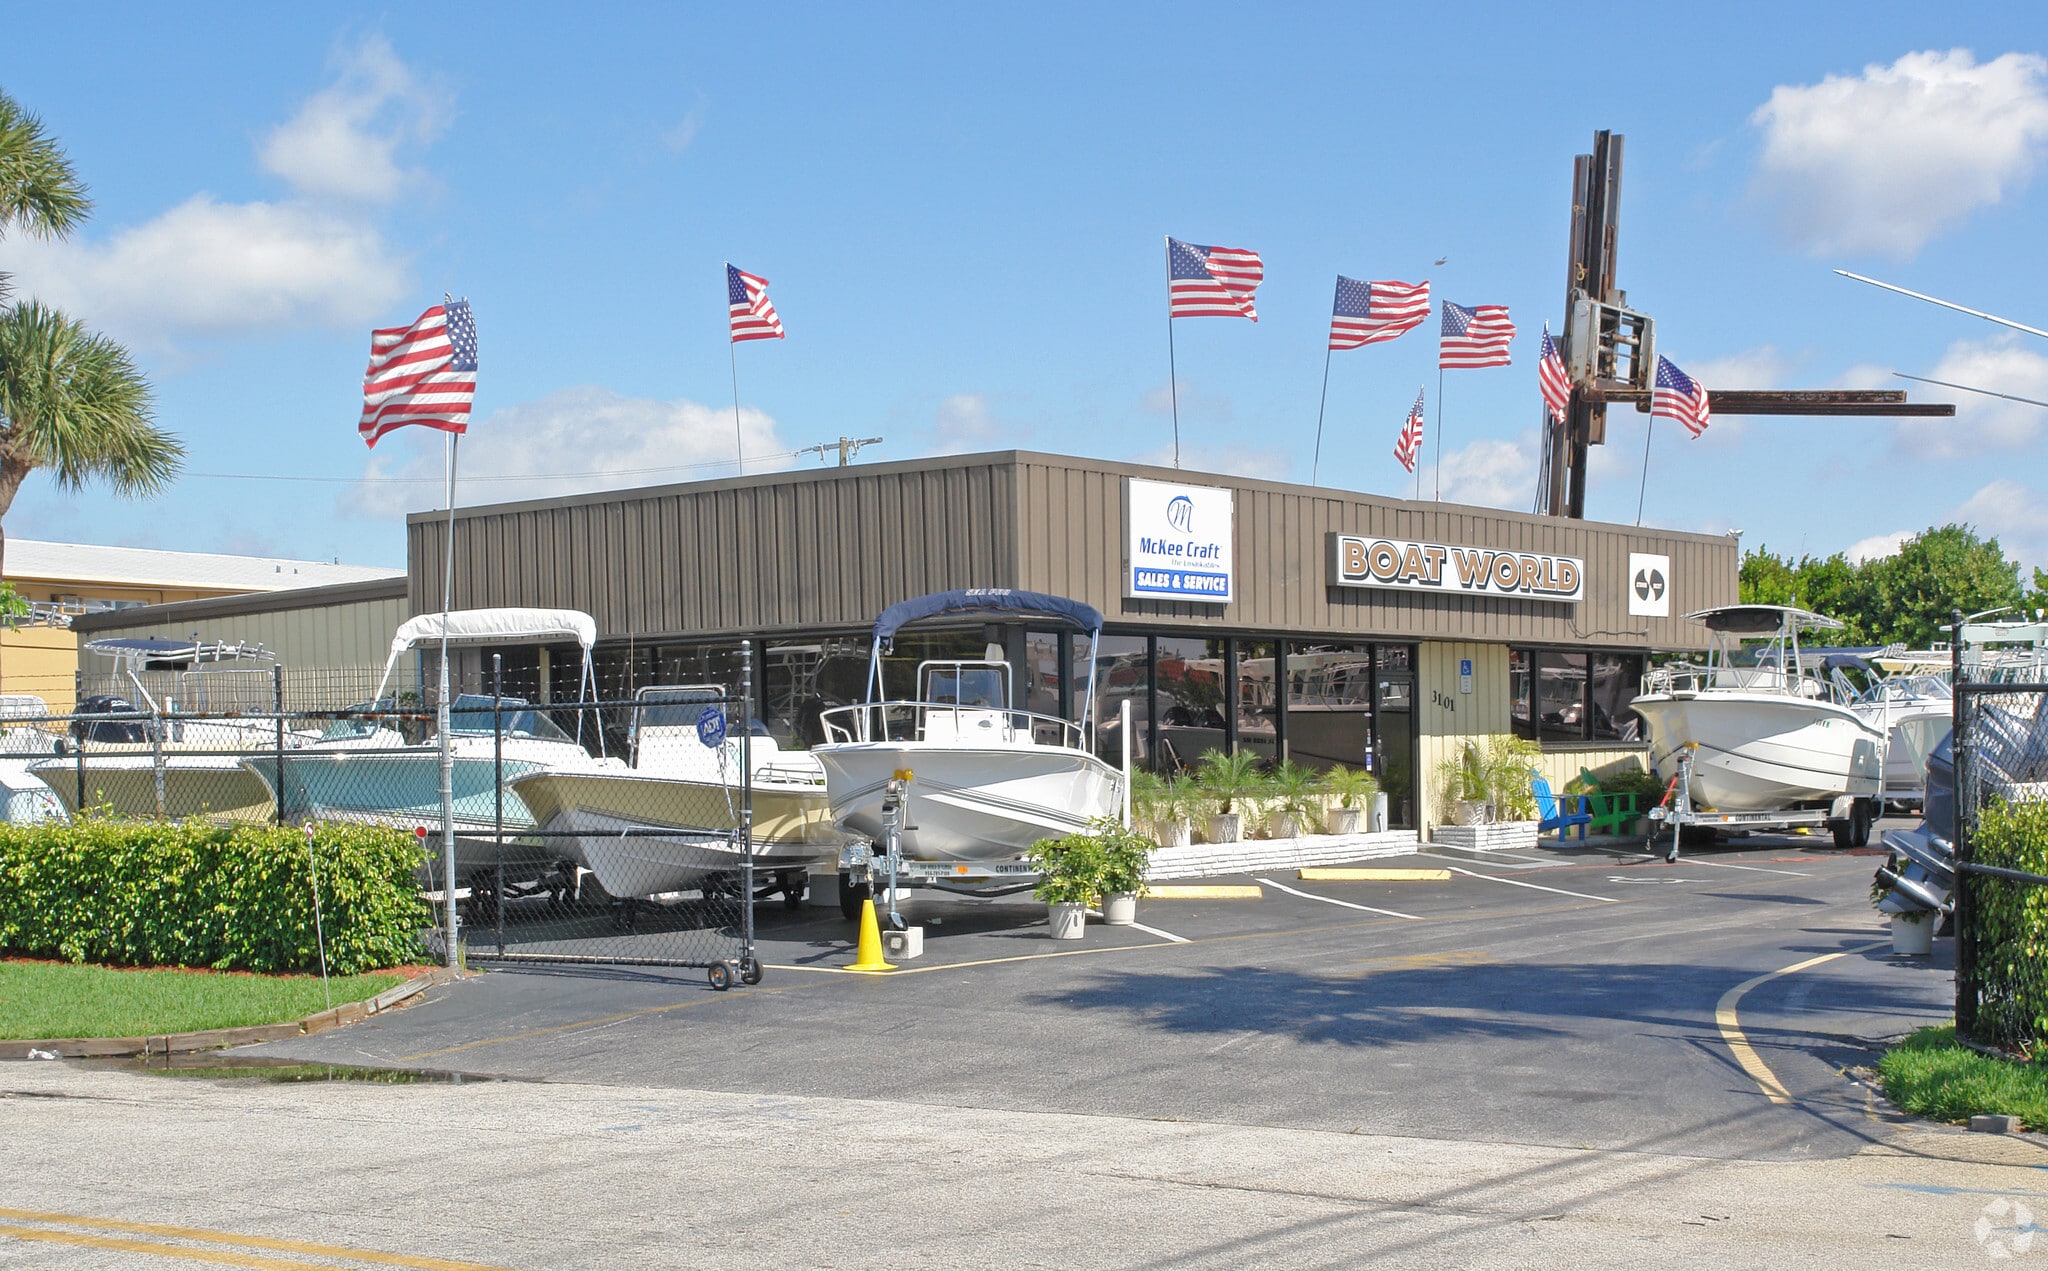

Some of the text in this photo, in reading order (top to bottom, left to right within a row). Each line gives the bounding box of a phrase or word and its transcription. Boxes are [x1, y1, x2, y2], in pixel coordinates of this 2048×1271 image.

[1139, 537, 1220, 559] McKee Craft
[1342, 538, 1581, 596] BOAT WORLD
[1137, 570, 1226, 592] SALES & SERVICE
[1432, 690, 1455, 712] 3101
[703, 717, 720, 735] ADT
